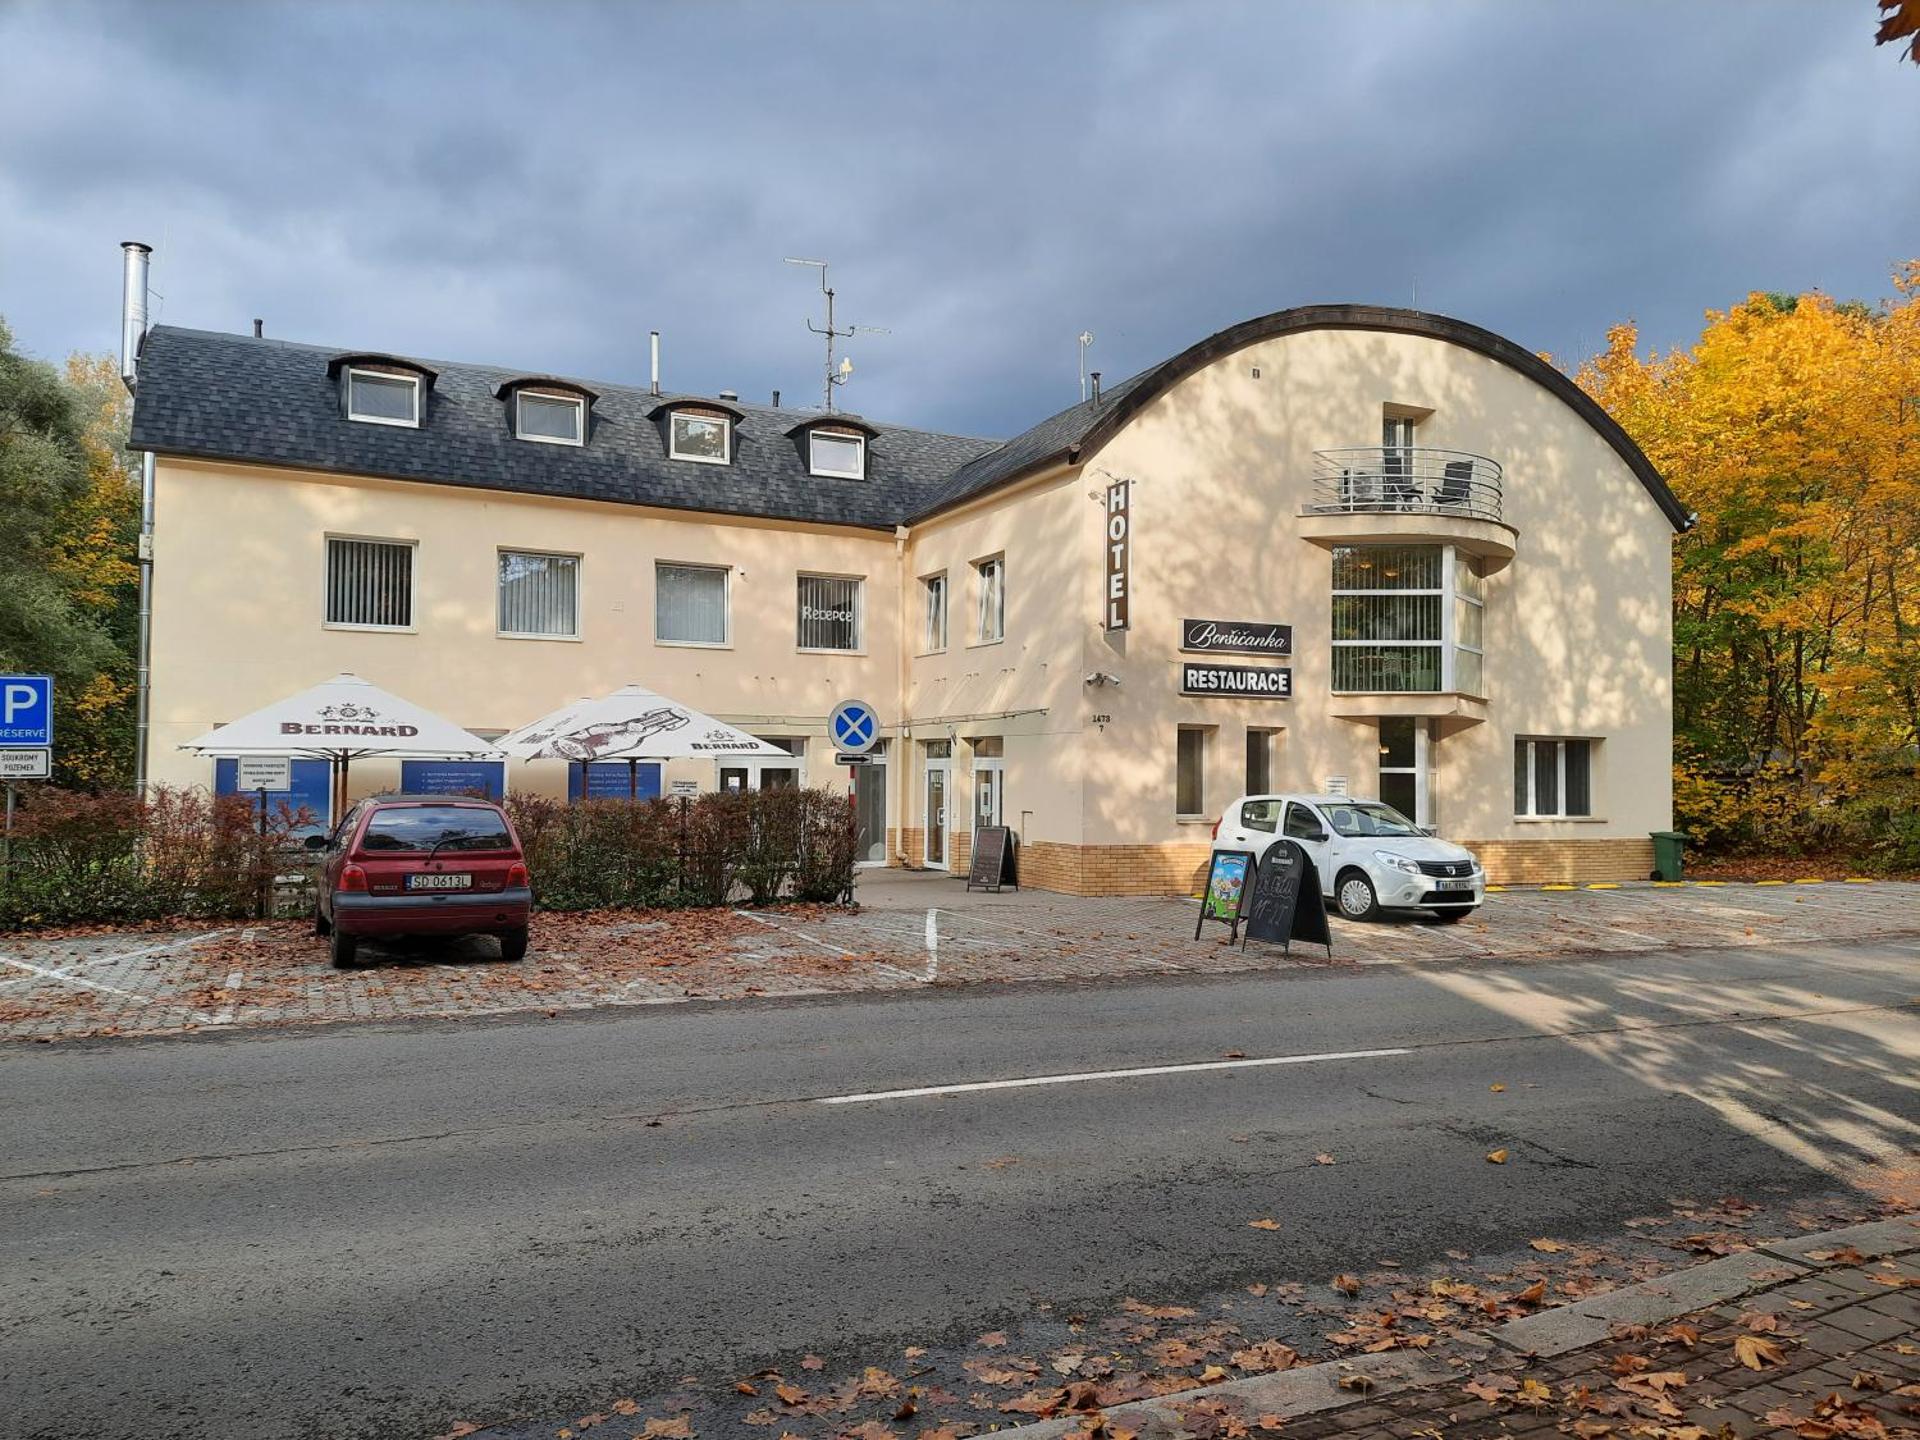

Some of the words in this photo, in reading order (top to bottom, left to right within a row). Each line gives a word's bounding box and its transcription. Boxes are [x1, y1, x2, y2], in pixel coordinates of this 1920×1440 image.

[1109, 484, 1126, 628] HOTEL
[803, 606, 854, 621] Recepce
[1188, 622, 1287, 648] Boršičanka
[1187, 669, 1288, 692] RESTAURACE
[5, 685, 38, 724] P
[280, 722, 418, 737] BERNARD
[691, 742, 760, 750] BERNARD
[414, 876, 430, 887] SD
[433, 876, 468, 887] 0613L
